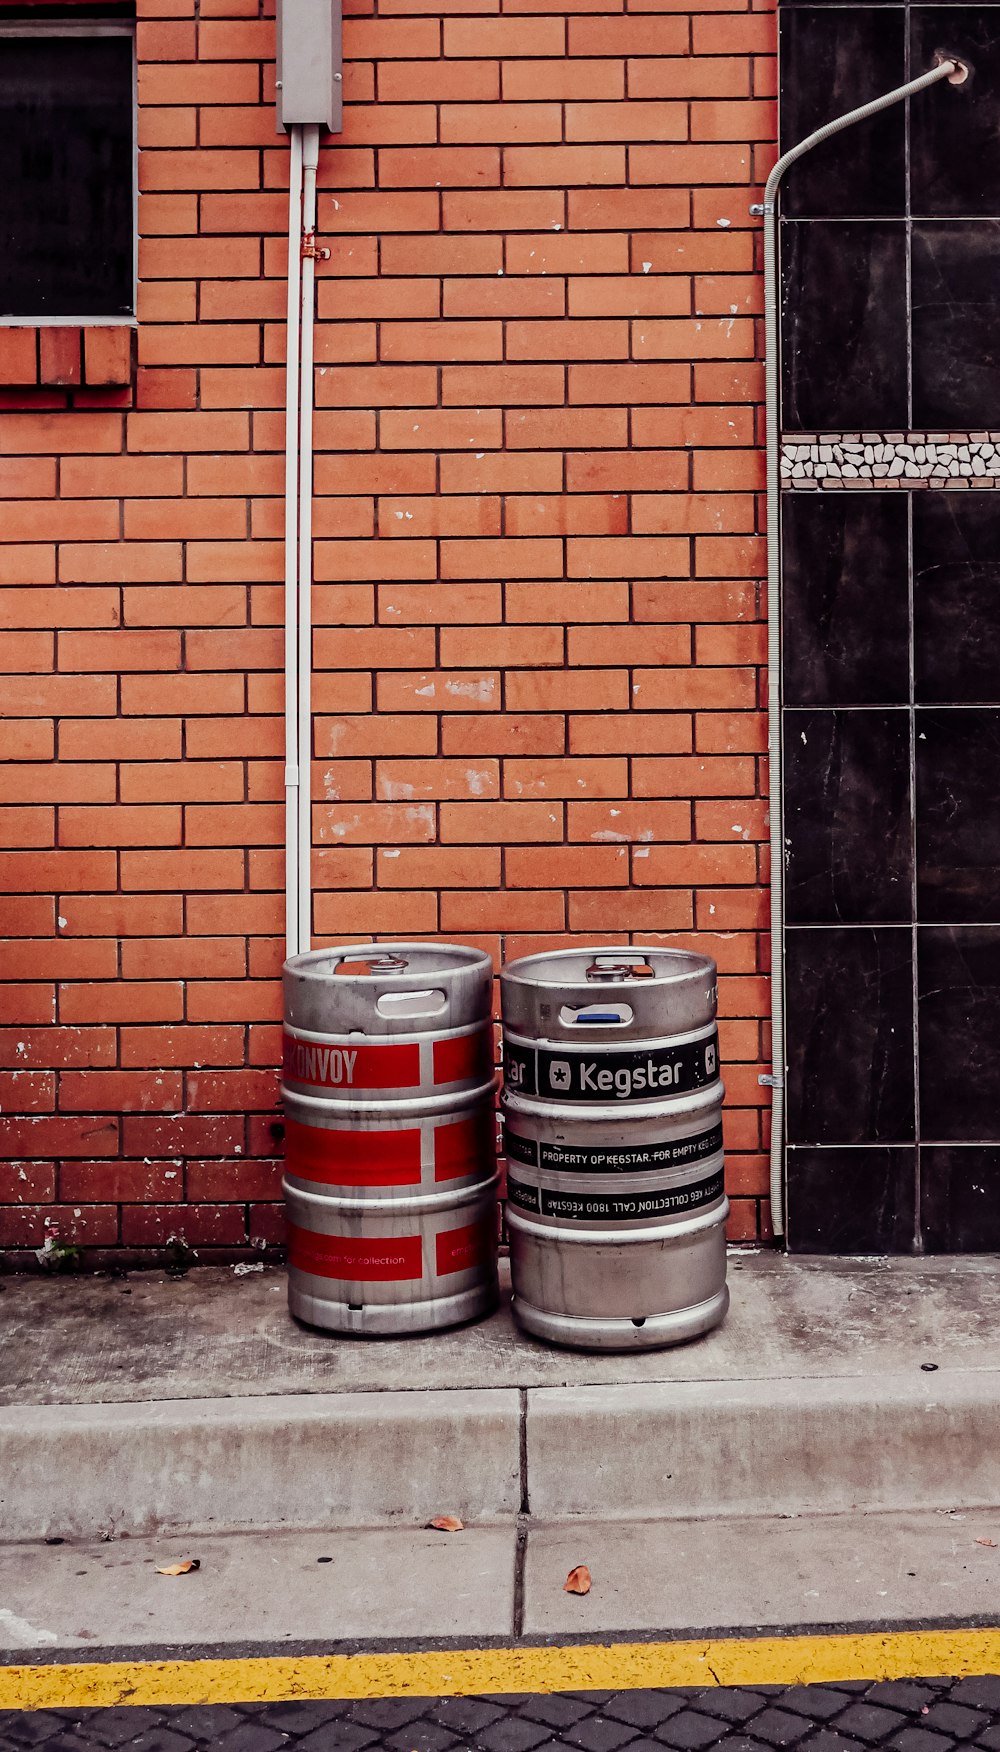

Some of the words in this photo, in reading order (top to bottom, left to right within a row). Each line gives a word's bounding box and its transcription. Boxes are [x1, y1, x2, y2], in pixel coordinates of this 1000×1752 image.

[580, 1060, 683, 1098] Kegstar
[543, 1151, 588, 1164] PROPERTY
[653, 1150, 671, 1161] FOR
[672, 1143, 697, 1158] EMPTY
[690, 1191, 702, 1202] KEG
[547, 1200, 583, 1212] KEGSTAR
[586, 1202, 609, 1212] 1800
[612, 1202, 636, 1212] CALL
[638, 1193, 689, 1213] COLLECTION
[358, 1256, 405, 1265] collection
